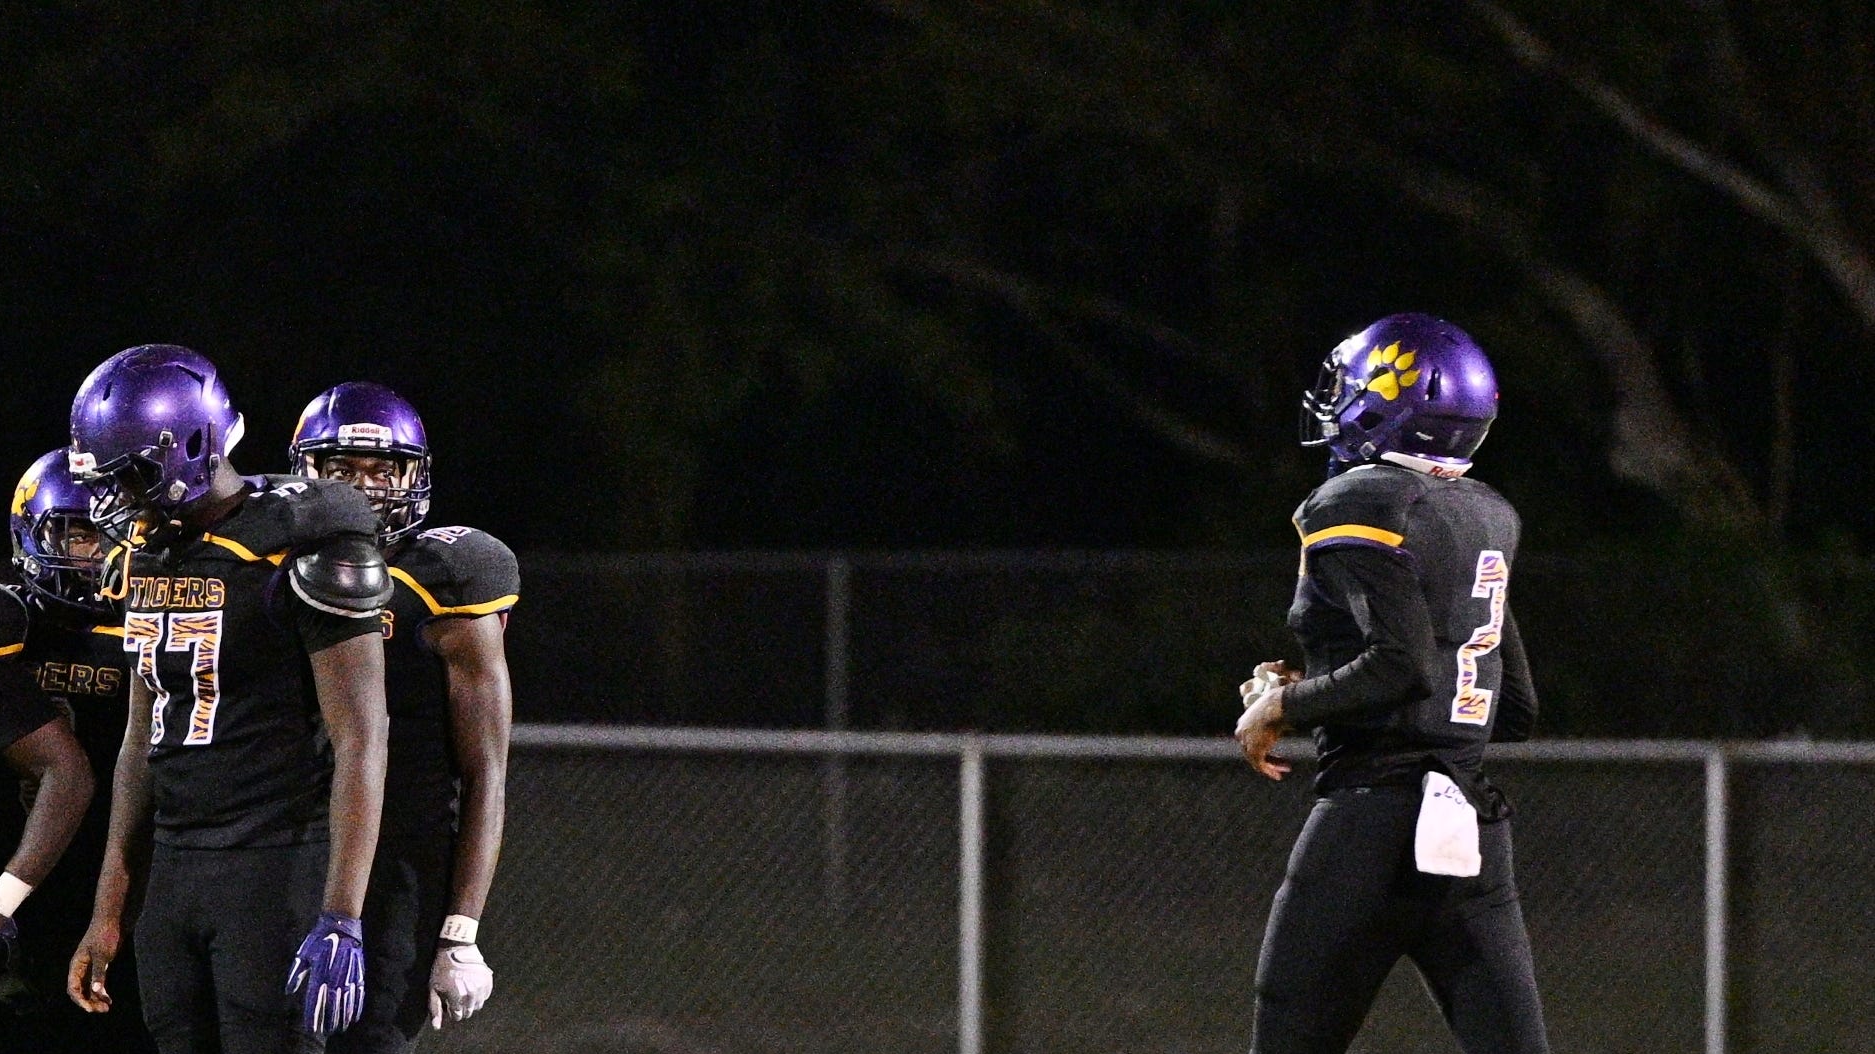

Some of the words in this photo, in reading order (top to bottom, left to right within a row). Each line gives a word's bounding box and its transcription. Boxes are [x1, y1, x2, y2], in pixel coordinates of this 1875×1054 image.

[128, 576, 225, 609] TIGERS
[1450, 550, 1509, 726] 2
[124, 610, 223, 746] 77
